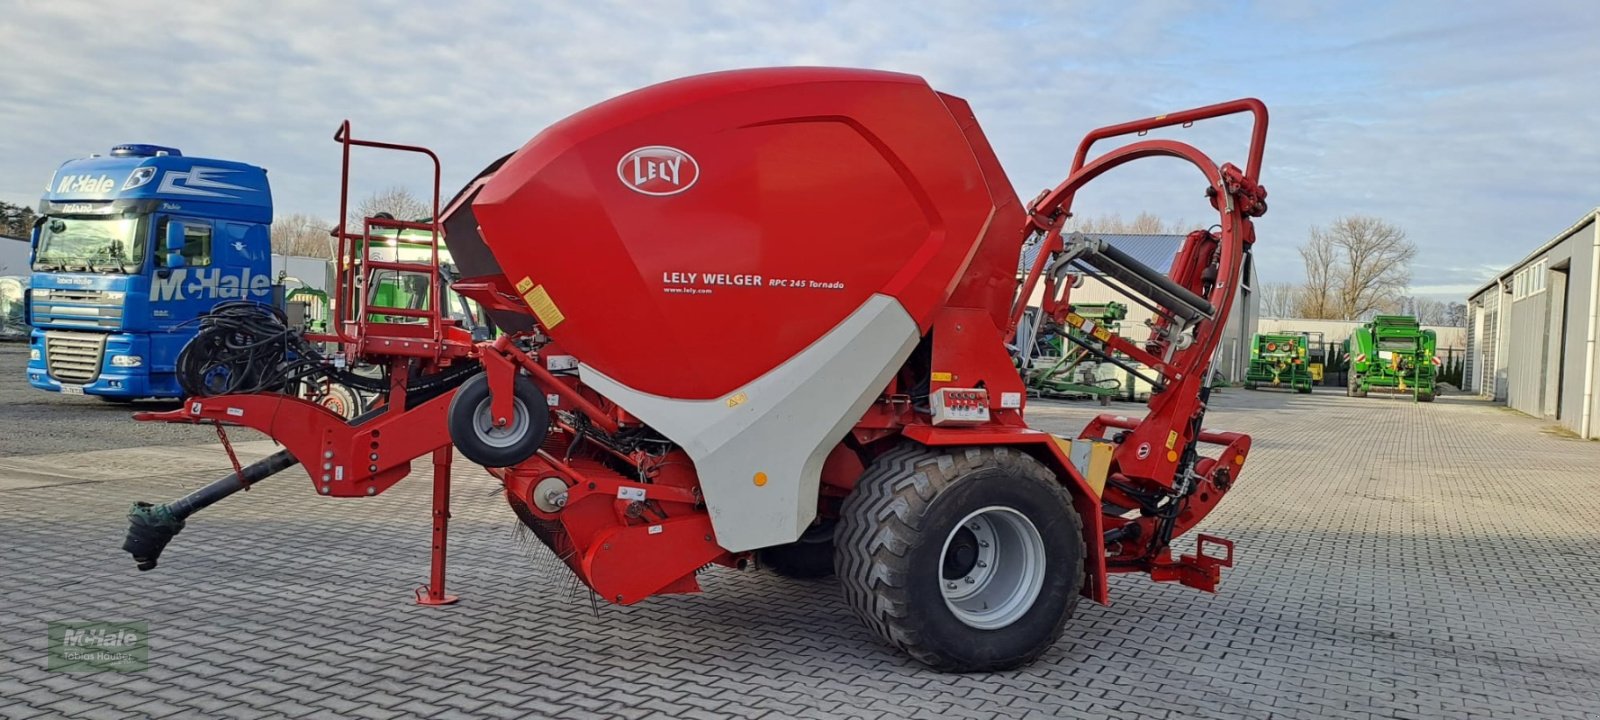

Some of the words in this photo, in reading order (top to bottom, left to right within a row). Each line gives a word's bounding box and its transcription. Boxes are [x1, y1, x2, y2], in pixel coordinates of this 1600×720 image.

[633, 154, 682, 186] LELY
[56, 174, 115, 193] McHale
[149, 267, 271, 301] McHale
[663, 271, 698, 284] LELY
[702, 273, 762, 286] WELGER
[768, 278, 788, 287] RPC
[789, 279, 806, 287] 245
[809, 280, 845, 289] Tornado
[663, 286, 713, 295] www.lely.com
